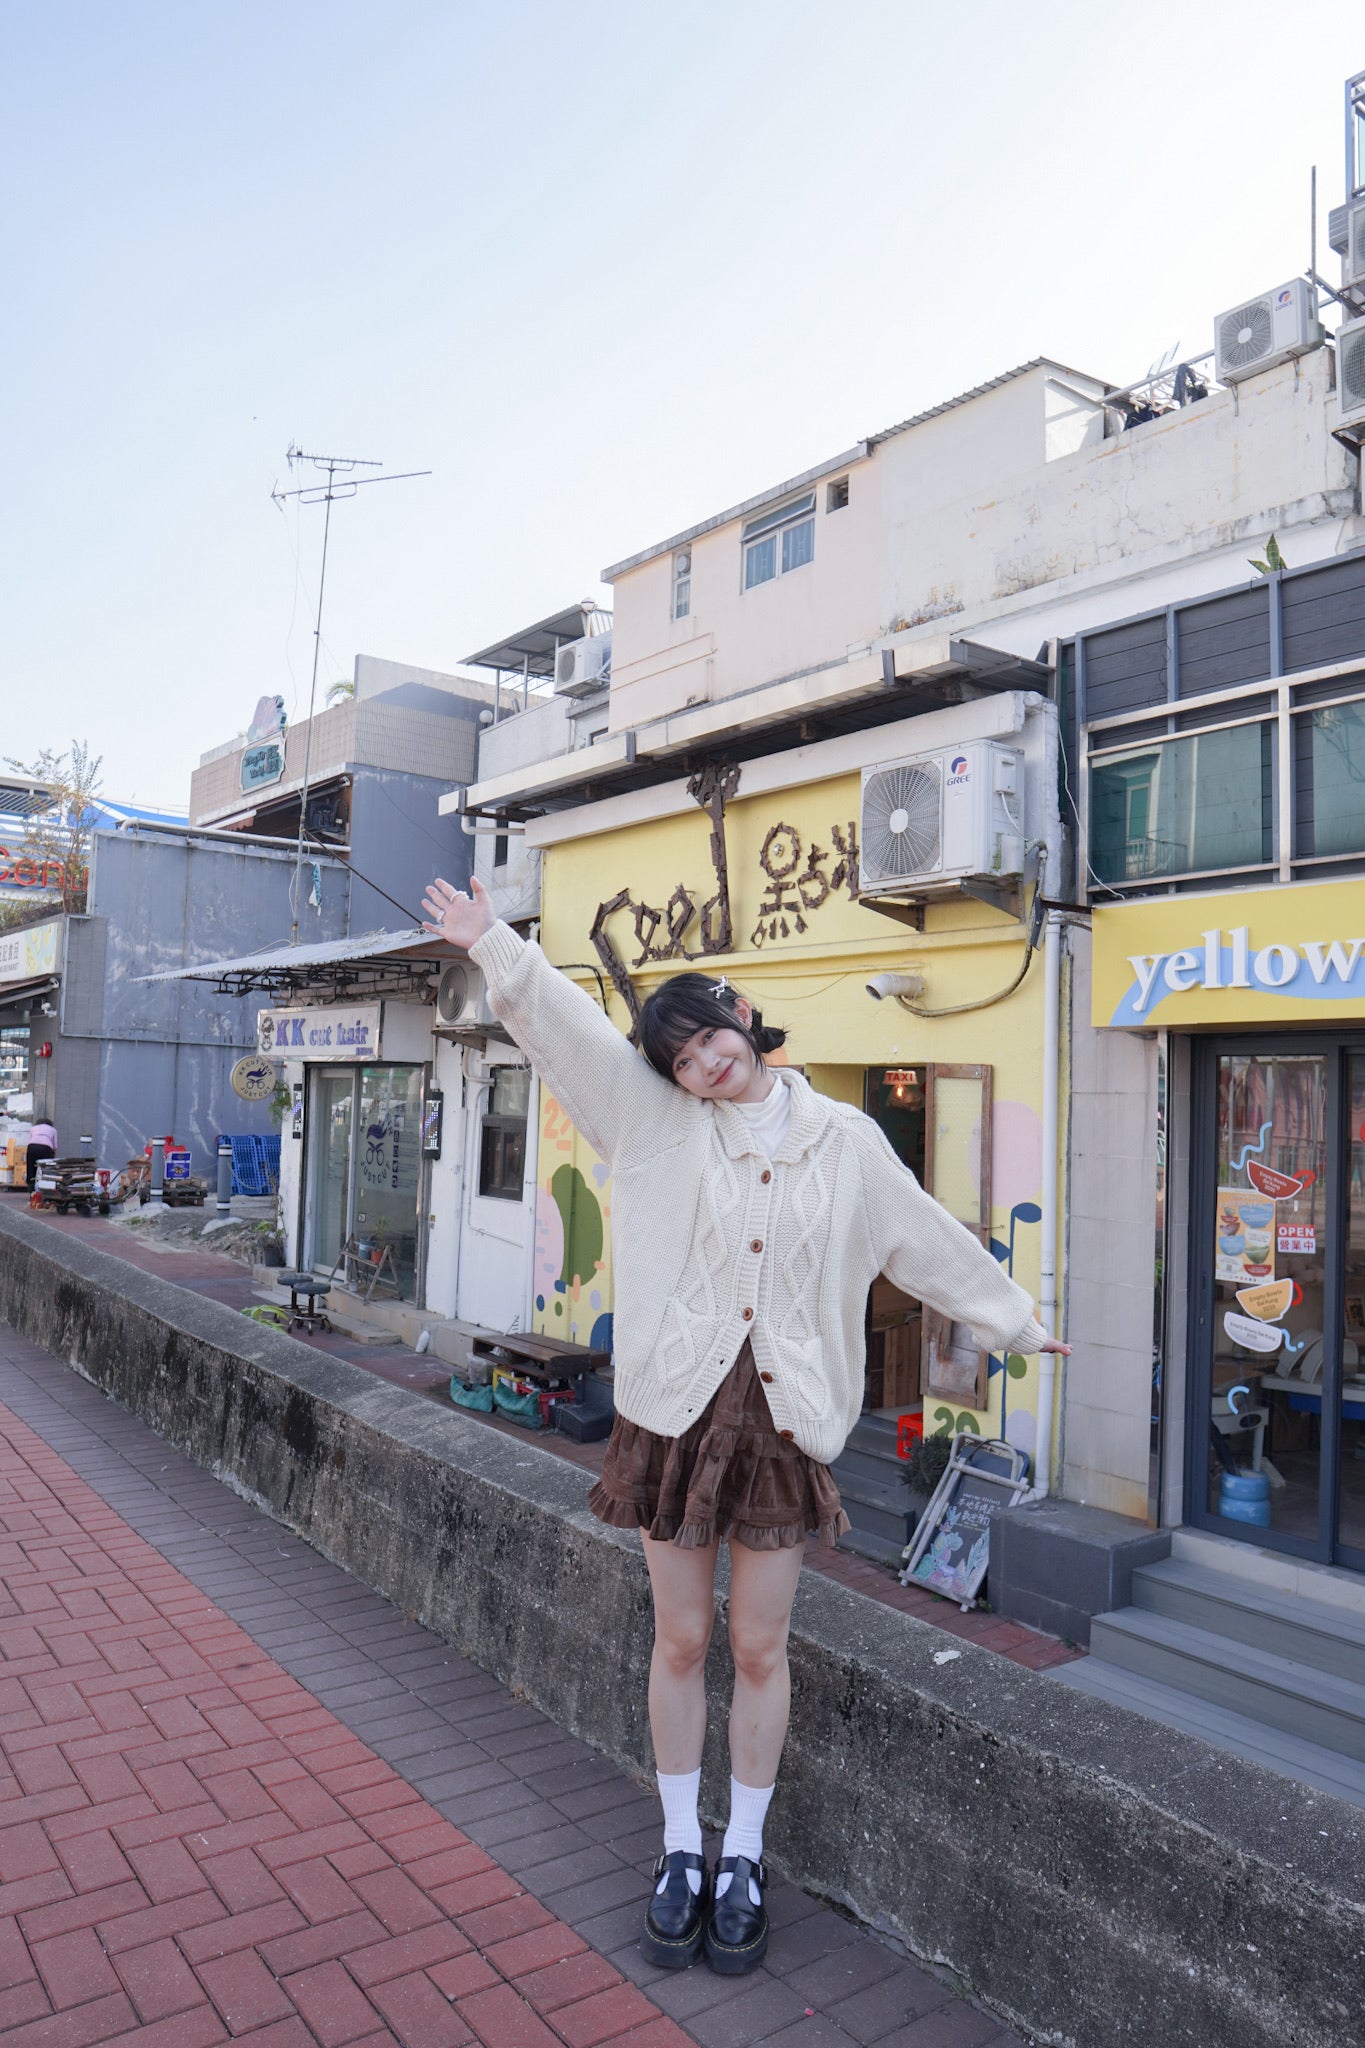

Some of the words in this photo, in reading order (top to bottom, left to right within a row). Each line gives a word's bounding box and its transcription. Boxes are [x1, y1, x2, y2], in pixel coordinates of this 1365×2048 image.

[946, 774, 972, 786] GREE
[1127, 926, 1365, 1012] yellow
[275, 1018, 306, 1046] KK
[309, 1025, 332, 1046] cut
[336, 1019, 369, 1045] hair
[886, 1072, 913, 1082] TAXI
[1279, 1226, 1314, 1237] OPEN
[1280, 1241, 1314, 1251] 營業中
